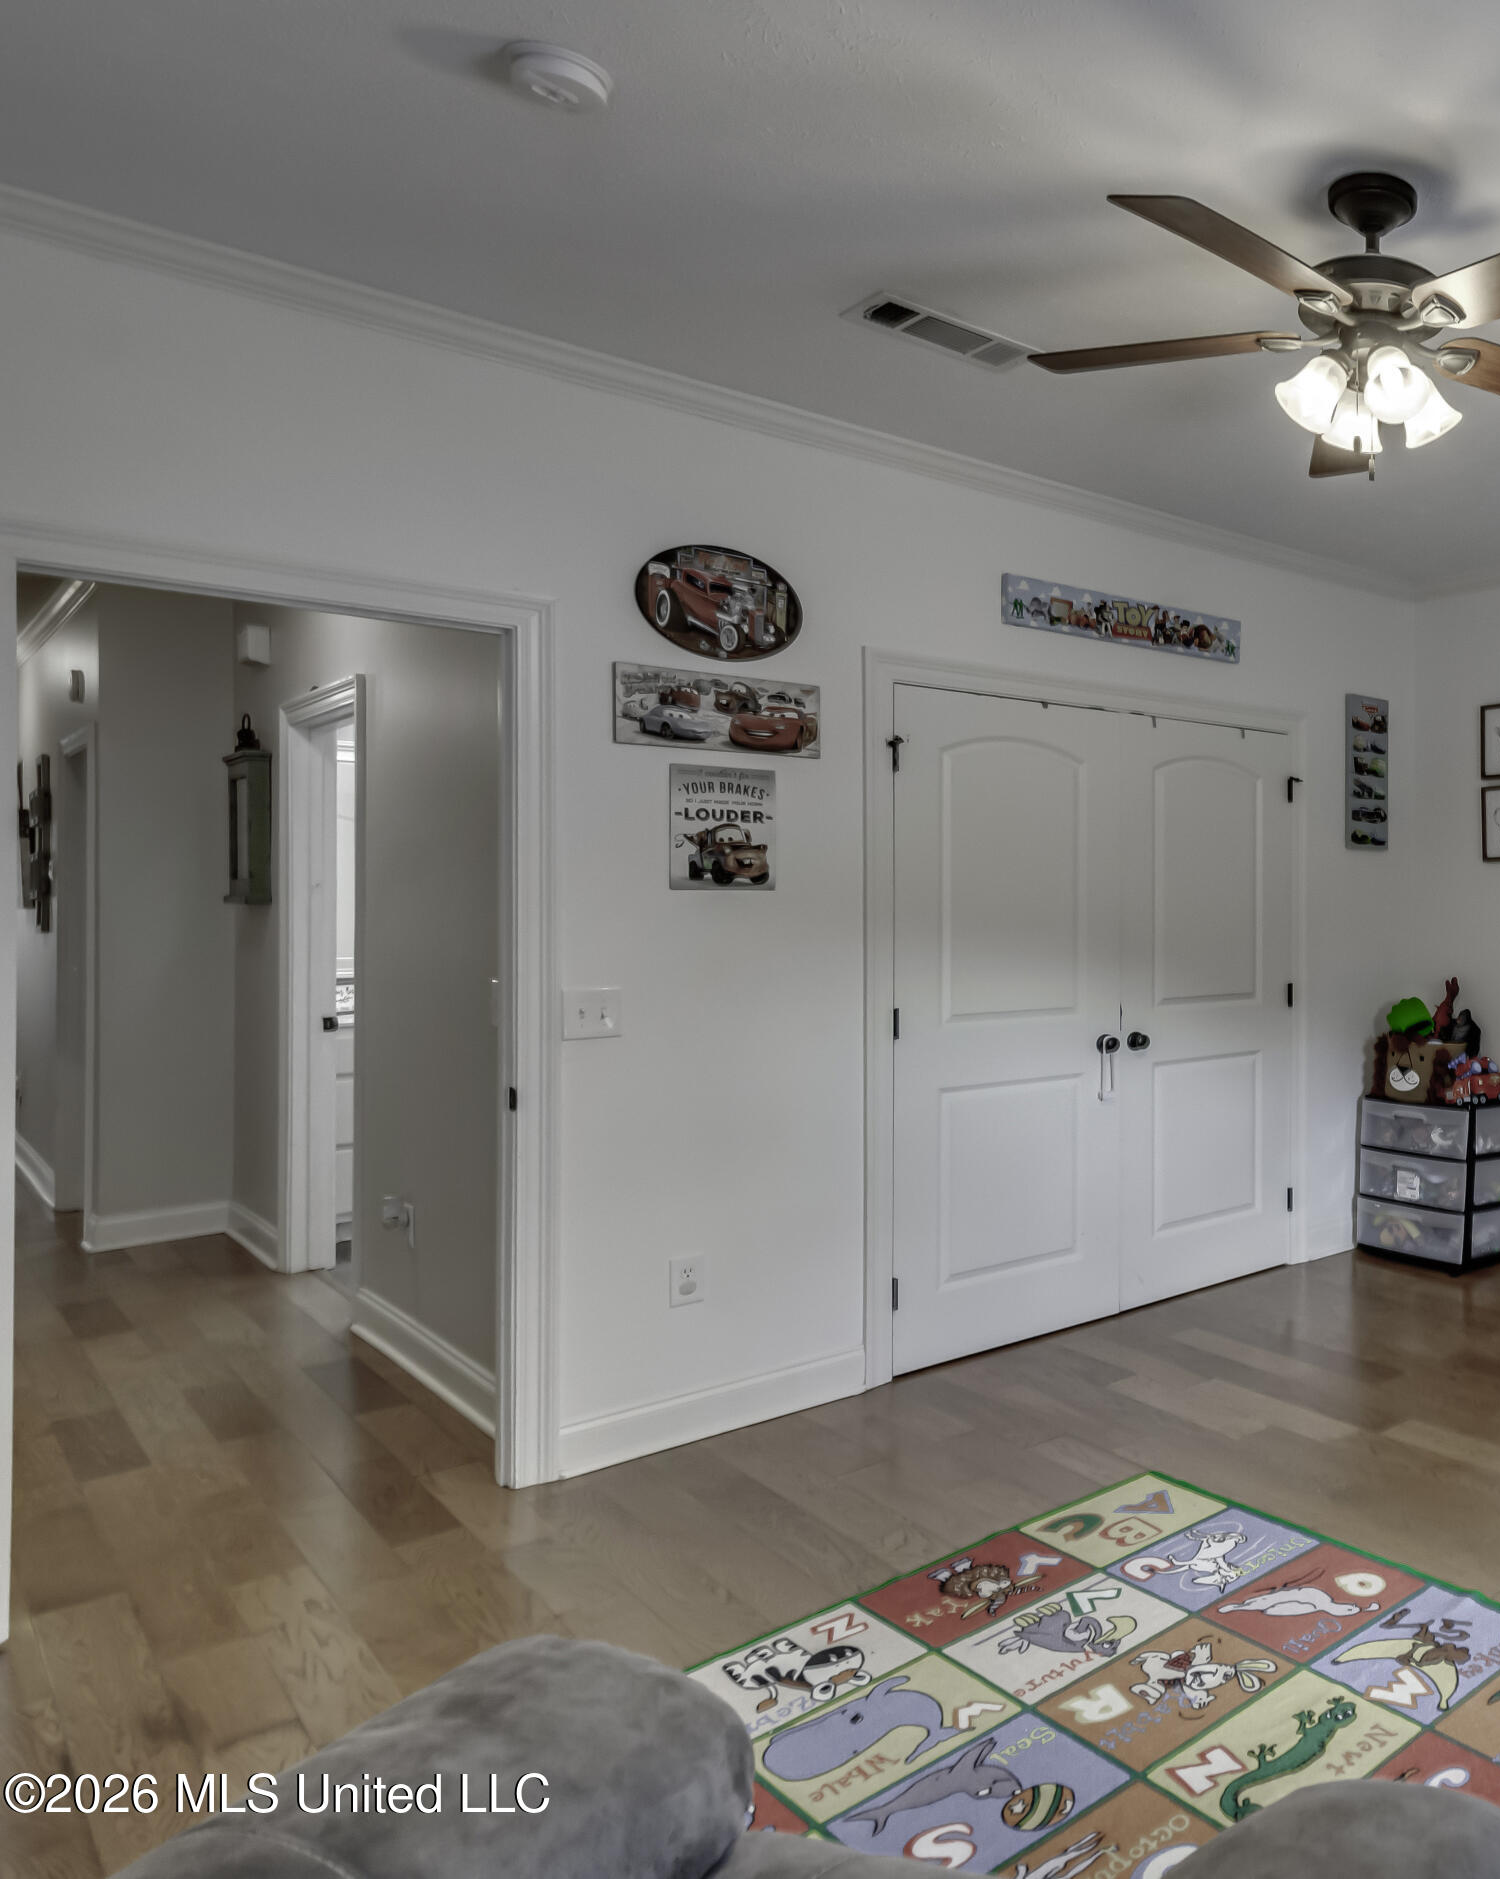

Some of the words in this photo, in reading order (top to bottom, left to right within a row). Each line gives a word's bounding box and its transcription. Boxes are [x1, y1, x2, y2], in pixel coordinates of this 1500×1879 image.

[1112, 600, 1153, 627] TOY
[682, 781, 715, 795] YOUR
[719, 781, 766, 801] BRAKES
[1113, 1489, 1174, 1514] A
[1100, 1516, 1162, 1548] B
[905, 1596, 968, 1627] Yak
[811, 1613, 869, 1645] Z
[1281, 1618, 1342, 1655] Quail
[1059, 1682, 1135, 1724] R
[1099, 1686, 1200, 1751] Rabbit
[989, 1726, 1057, 1766] Seal
[1325, 1723, 1399, 1778] Newt
[808, 1752, 902, 1803] Whale
